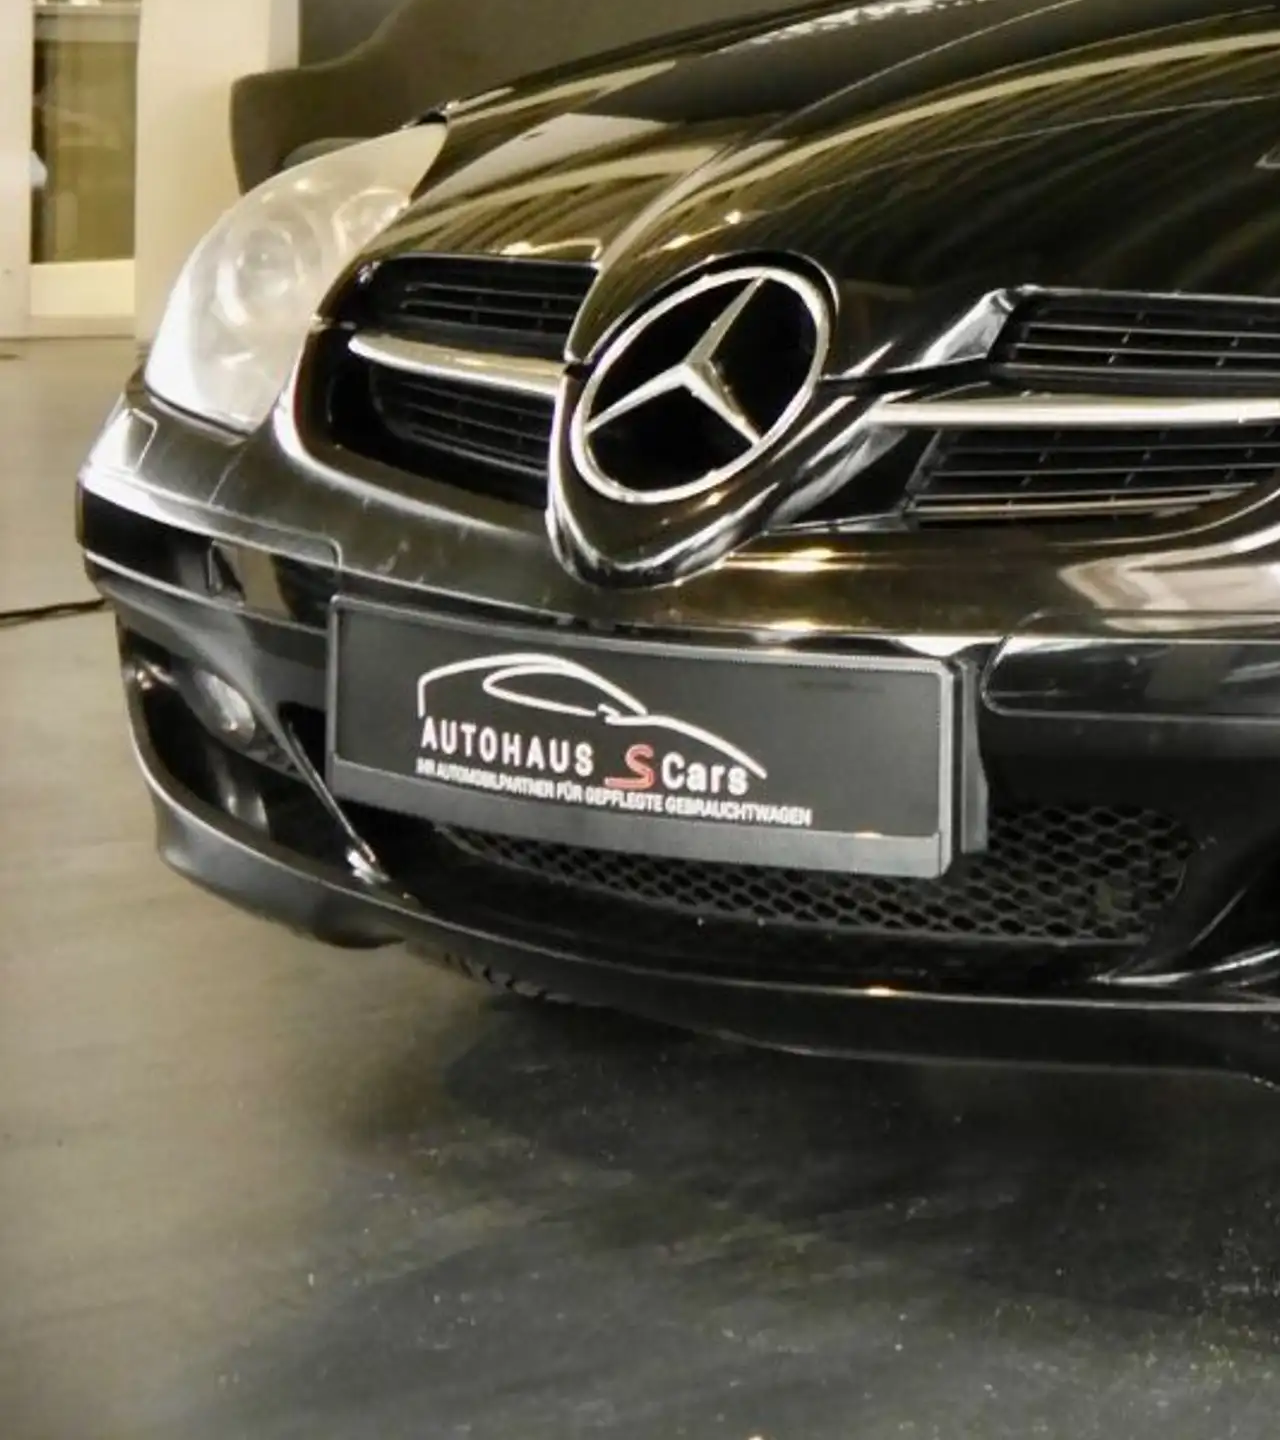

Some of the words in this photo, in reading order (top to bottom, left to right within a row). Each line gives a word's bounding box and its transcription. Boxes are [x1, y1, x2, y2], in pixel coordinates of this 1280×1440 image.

[420, 715, 595, 777] AUTOHAUS
[604, 743, 656, 791] S
[661, 751, 749, 796] Cars
[437, 761, 555, 799] AUTOMOBILPARTNER
[556, 779, 583, 803] FÜR
[585, 784, 664, 812] GEPFLEGTE
[664, 794, 814, 828] GEBRAUCHTWAGEN
